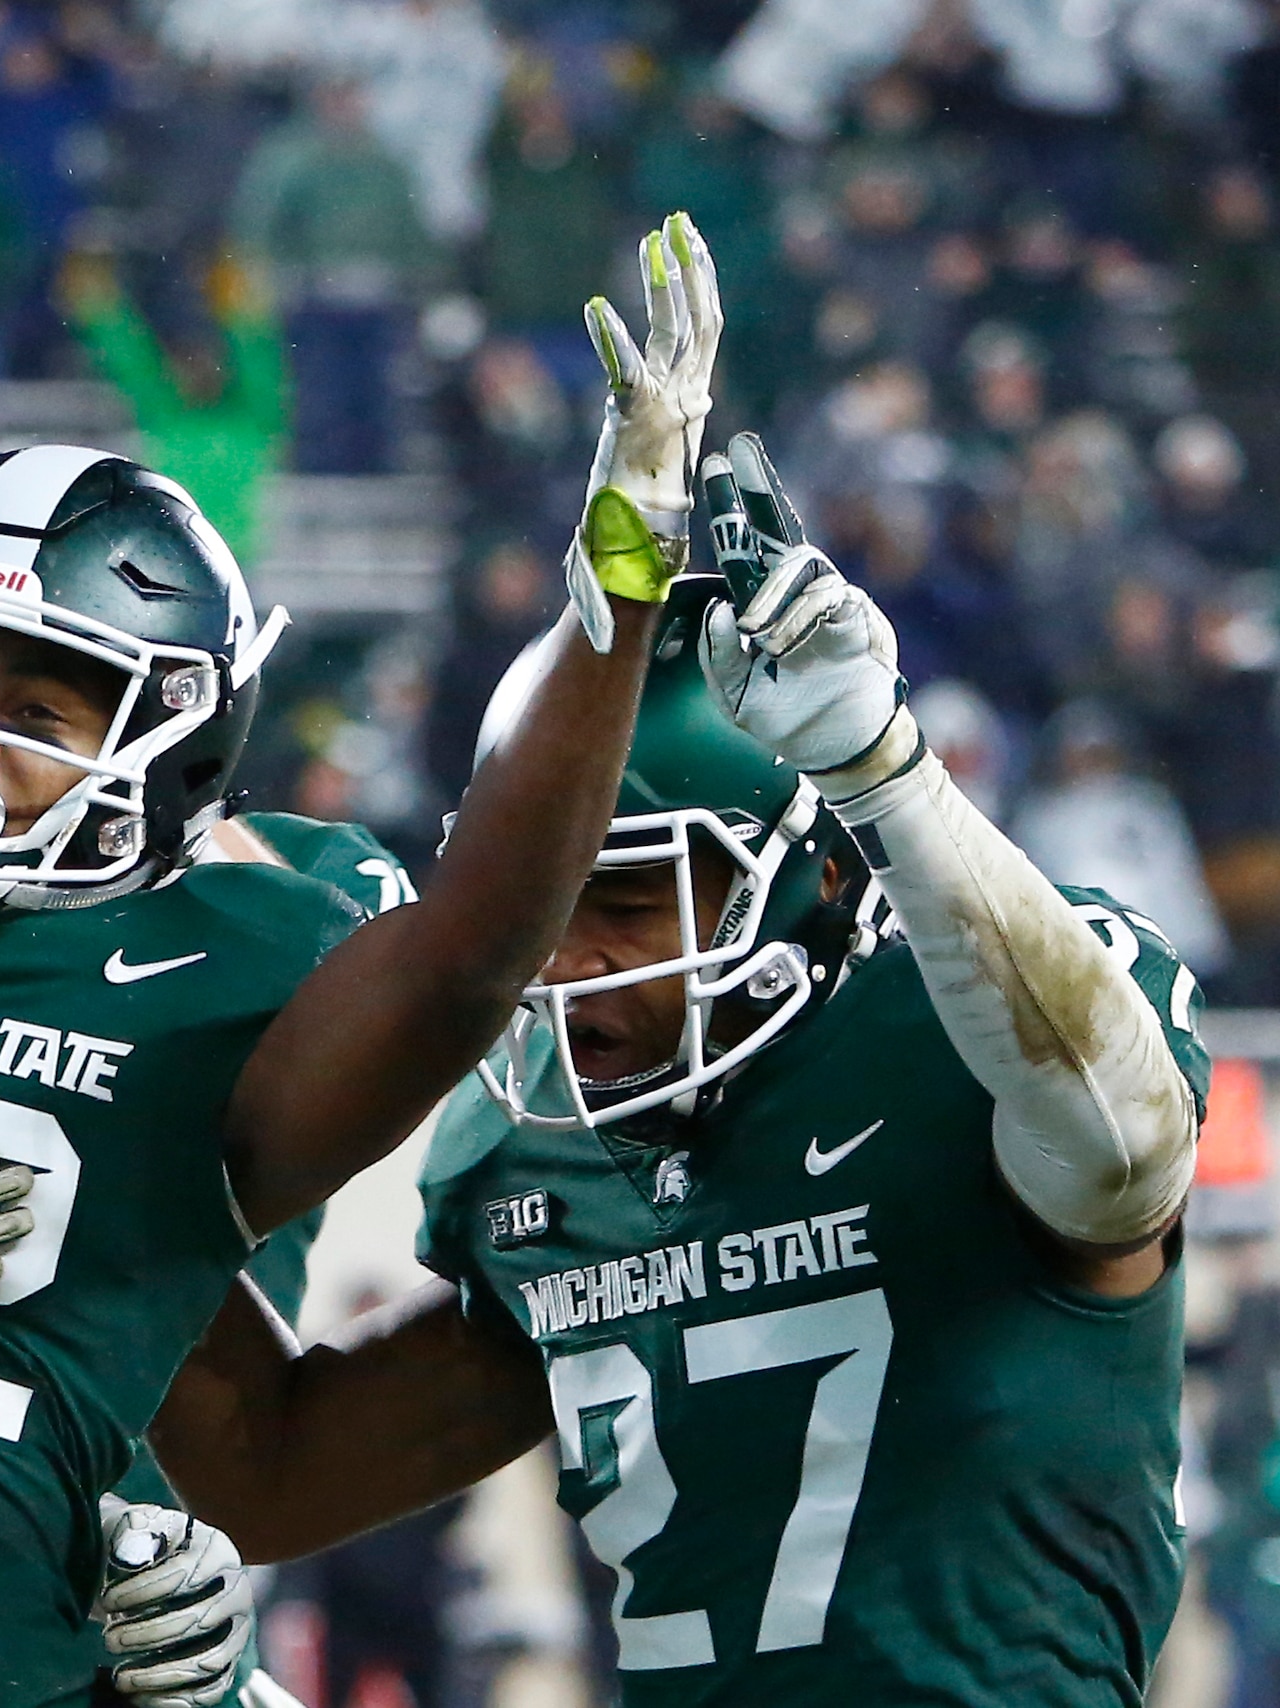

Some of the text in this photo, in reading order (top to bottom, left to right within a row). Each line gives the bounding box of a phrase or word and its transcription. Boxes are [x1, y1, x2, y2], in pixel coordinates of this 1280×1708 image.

[517, 1203, 879, 1340] MICHIGAN STATE
[549, 1287, 894, 1672] 27
